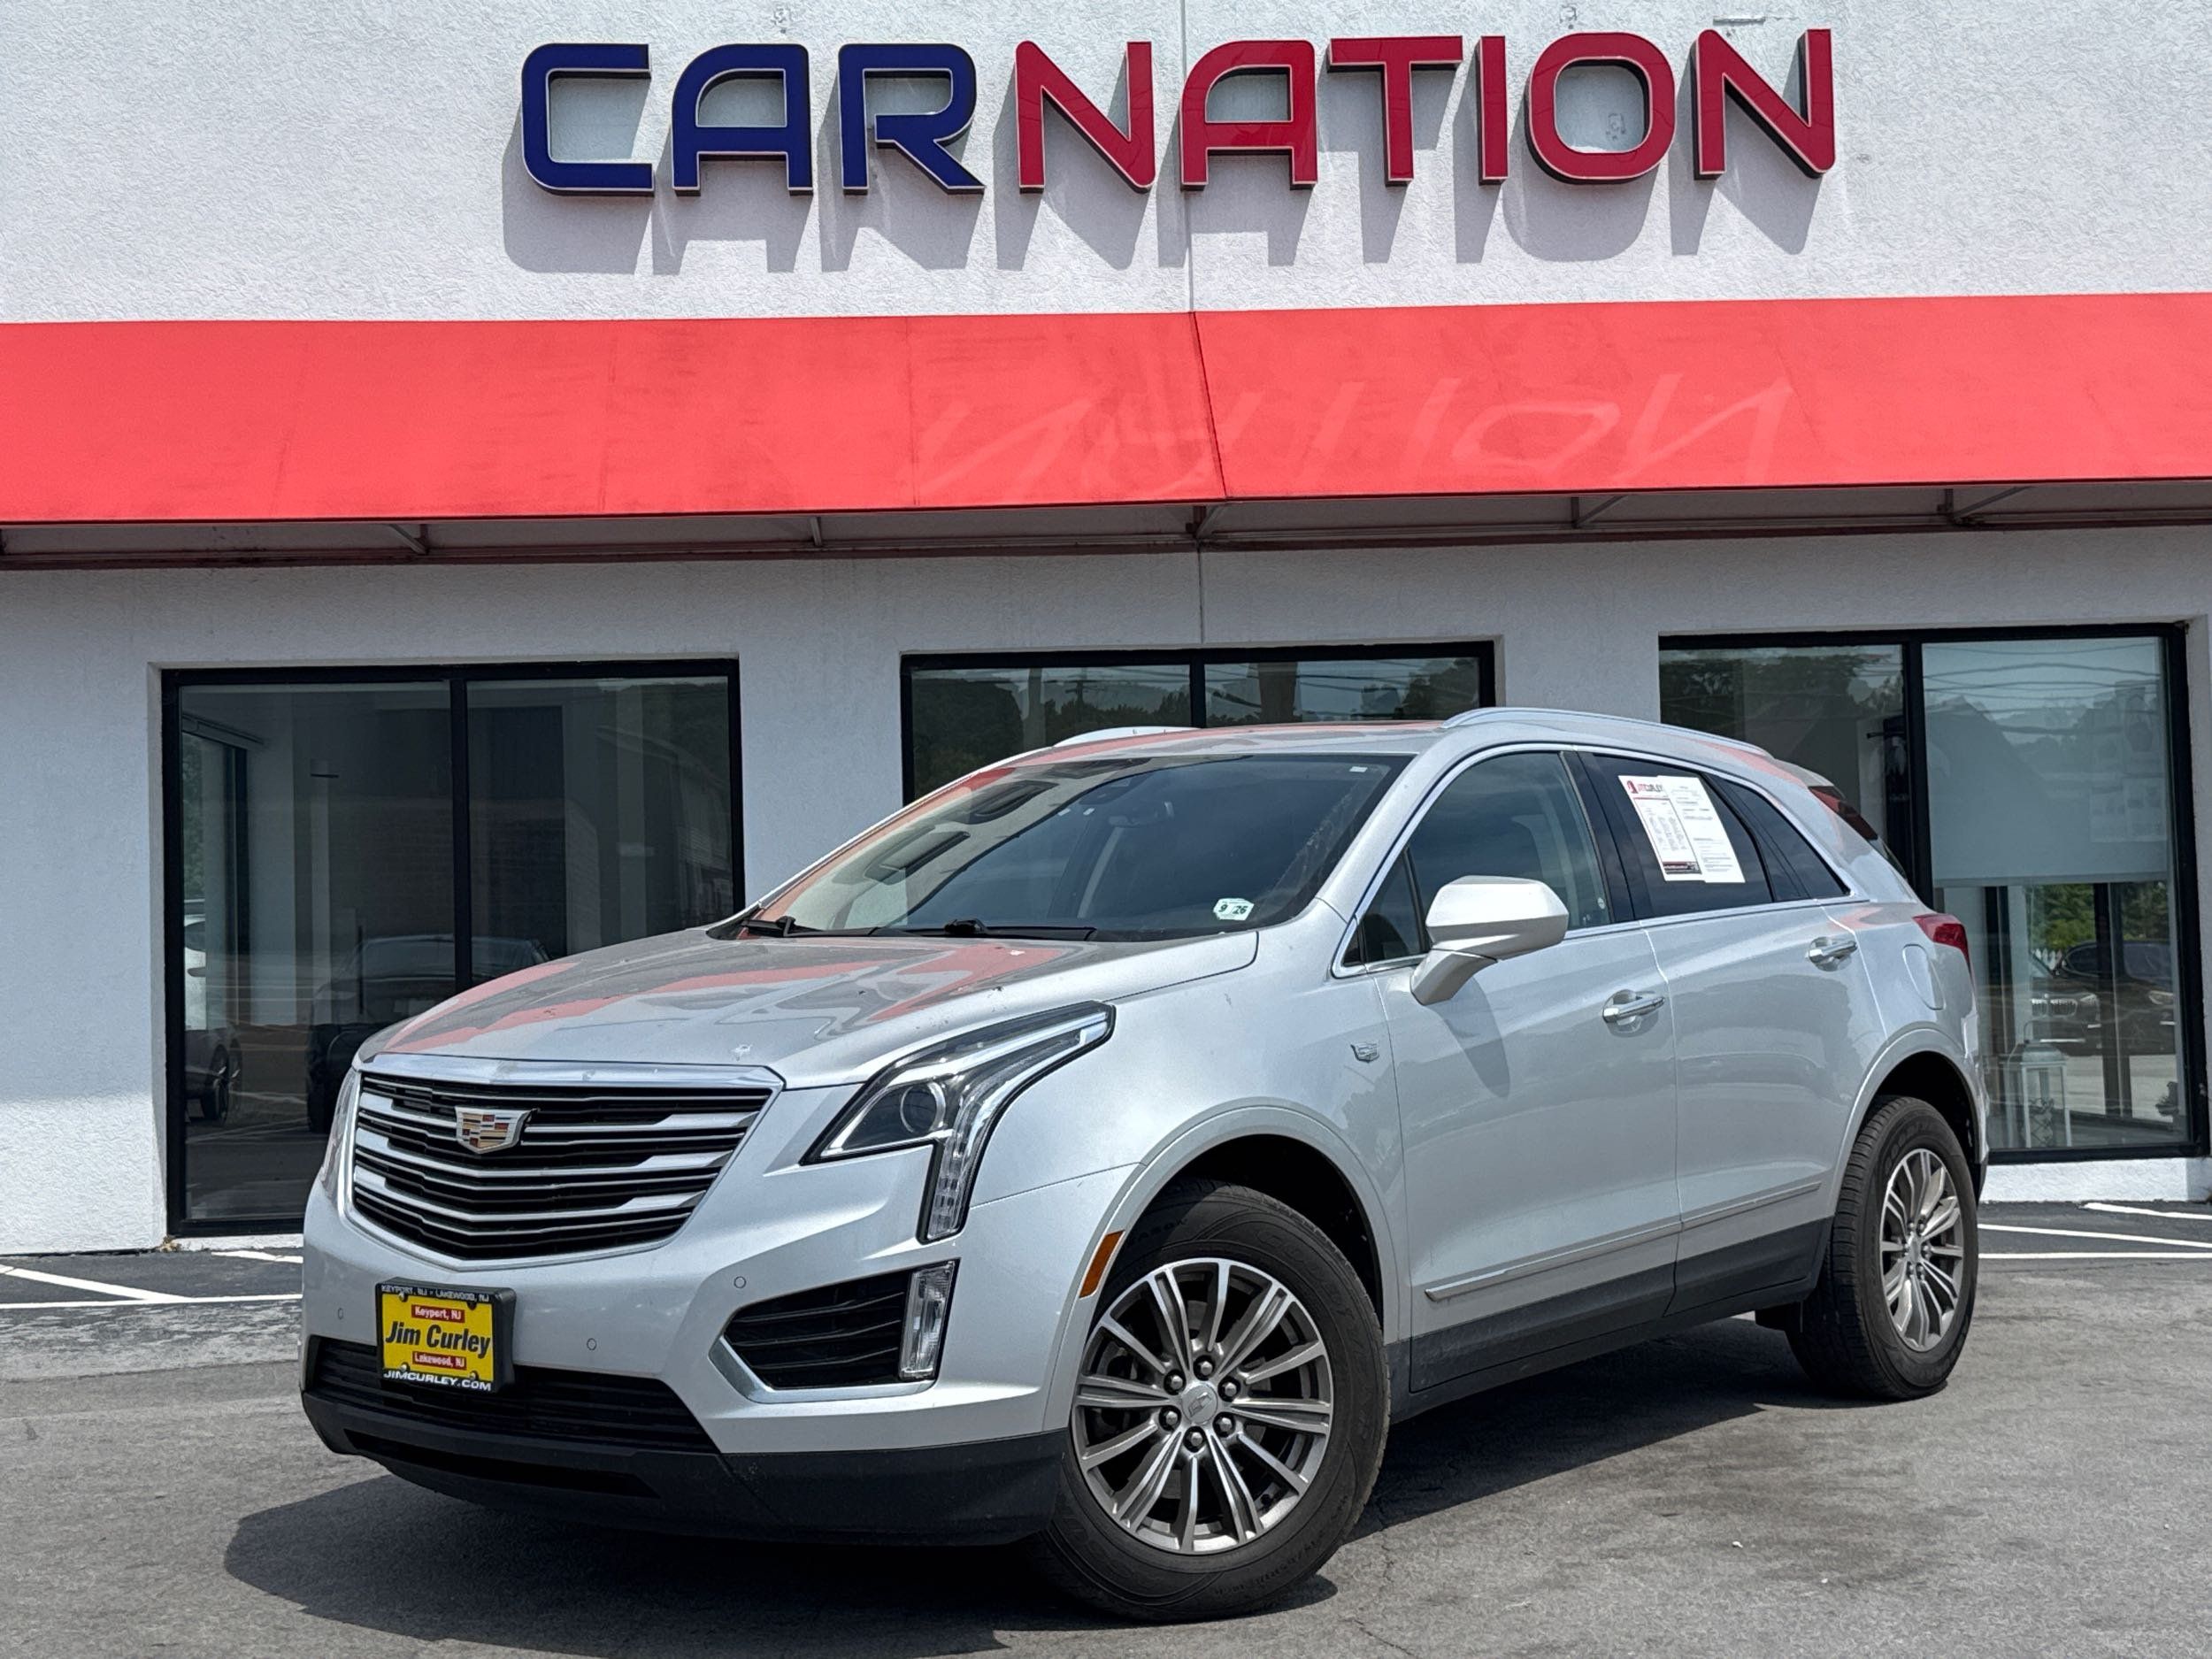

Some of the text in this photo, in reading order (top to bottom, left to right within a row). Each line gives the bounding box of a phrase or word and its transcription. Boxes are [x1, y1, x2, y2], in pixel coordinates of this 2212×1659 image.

[521, 28, 1836, 196] CARNATION
[415, 1306, 462, 1320] Keyport, NJ
[386, 1321, 491, 1359] Jim Curley
[456, 1358, 465, 1368] NJ
[383, 1371, 492, 1392] JIMCURLEY.COM
